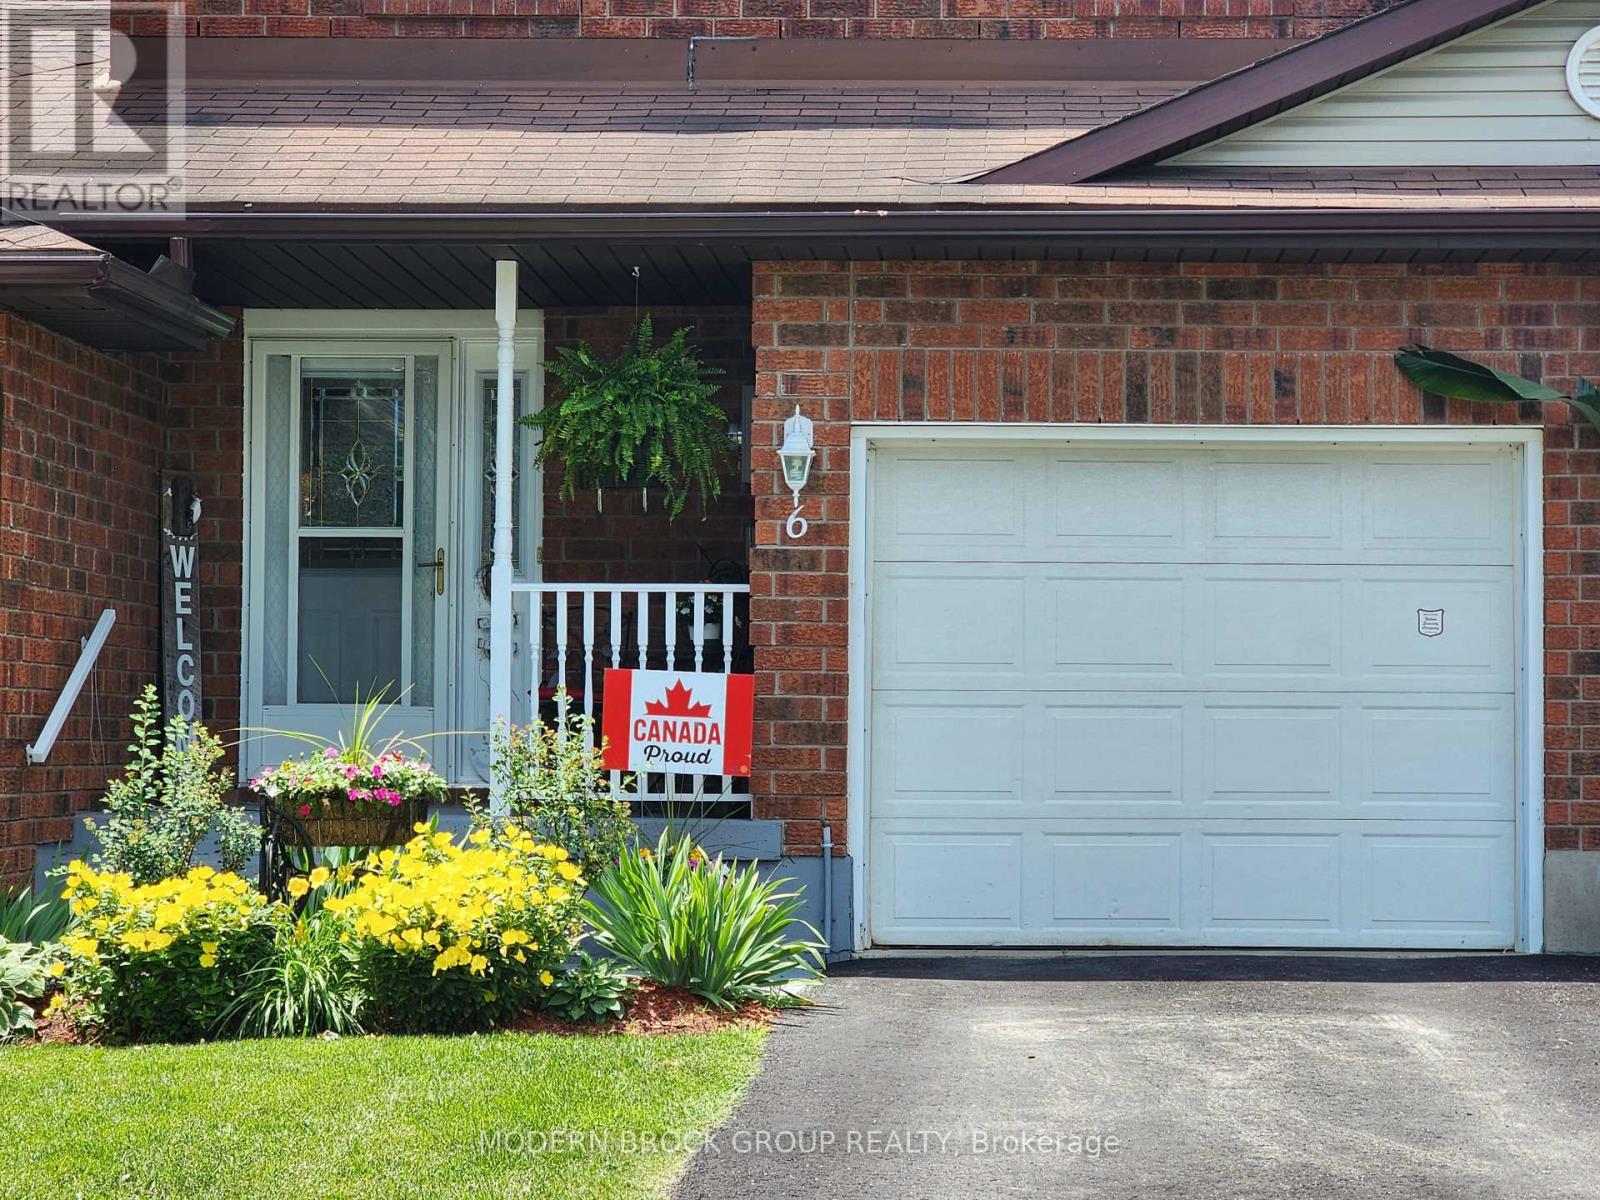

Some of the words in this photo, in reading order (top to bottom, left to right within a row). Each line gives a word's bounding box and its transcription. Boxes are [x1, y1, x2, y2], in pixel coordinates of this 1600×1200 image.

[786, 505, 808, 538] 6
[633, 719, 721, 745] CANADA
[644, 745, 712, 764] Proud
